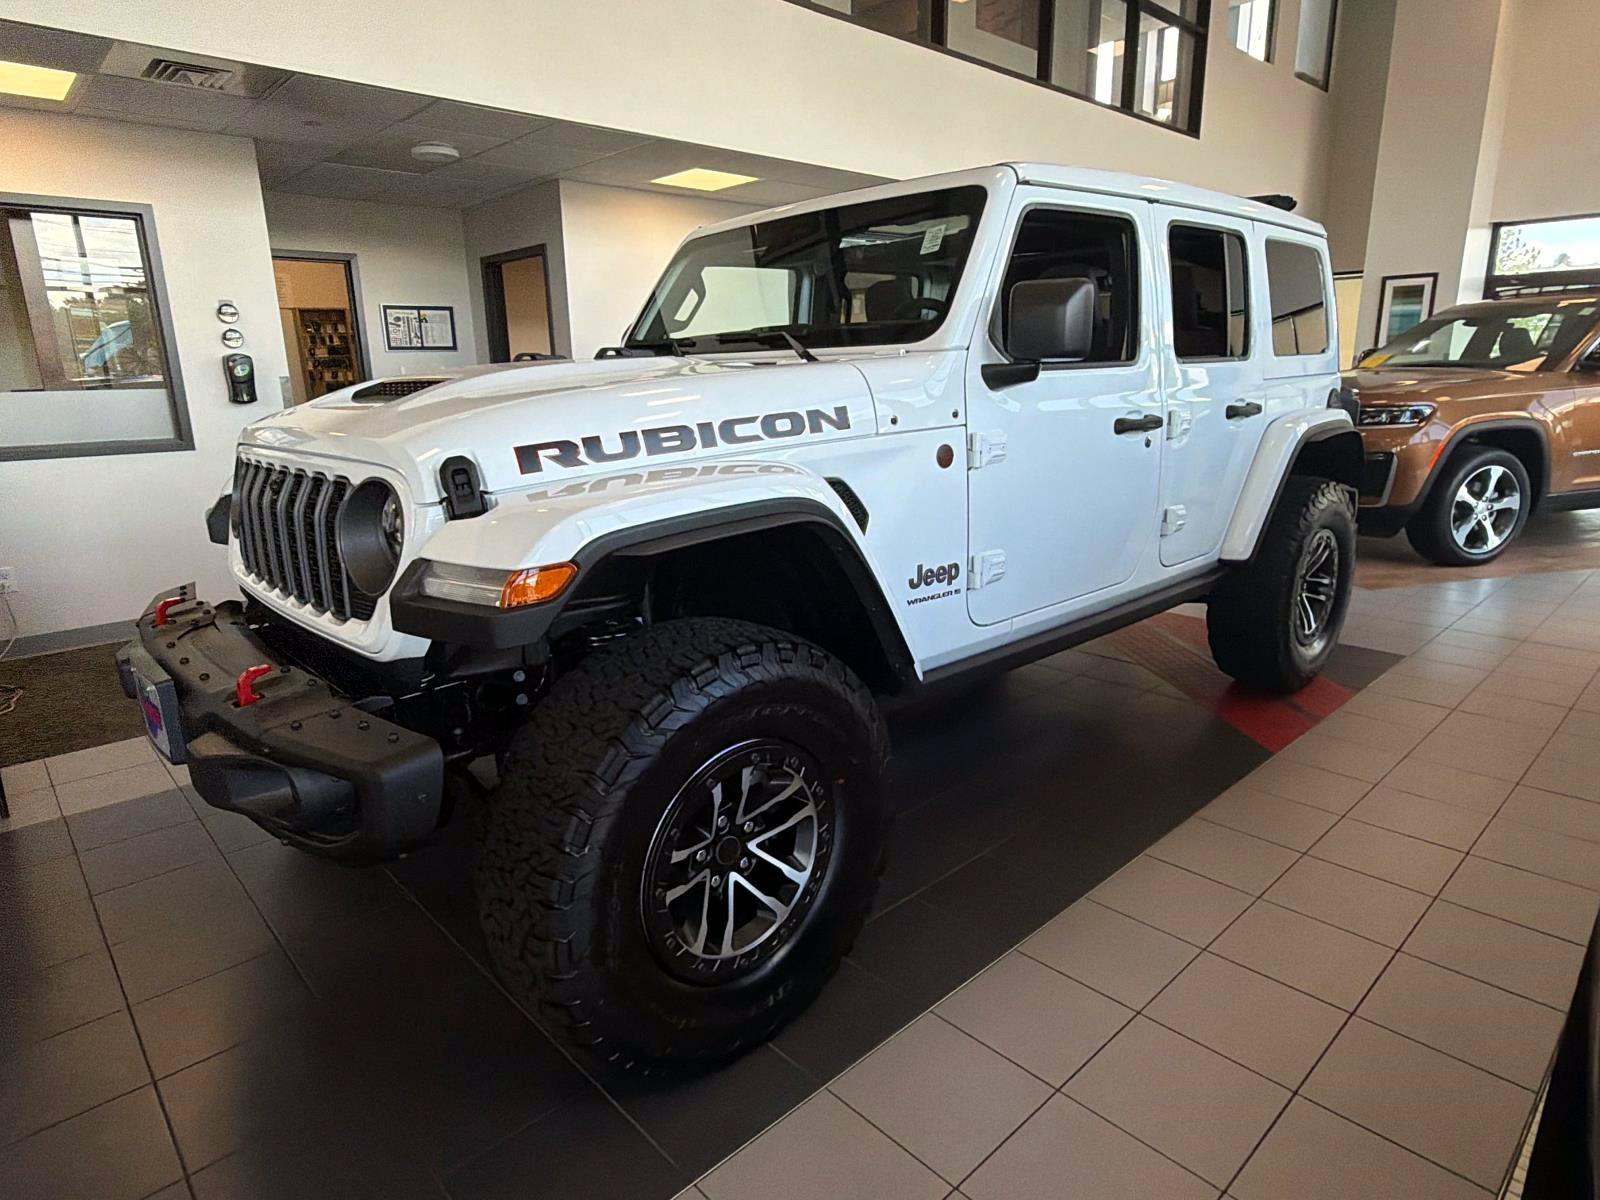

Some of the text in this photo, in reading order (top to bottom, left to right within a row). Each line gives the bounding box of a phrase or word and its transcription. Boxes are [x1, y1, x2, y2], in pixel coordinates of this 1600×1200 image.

[513, 405, 851, 475] RUBICON
[908, 562, 960, 590] Jeep
[907, 590, 953, 606] WRANGLER
